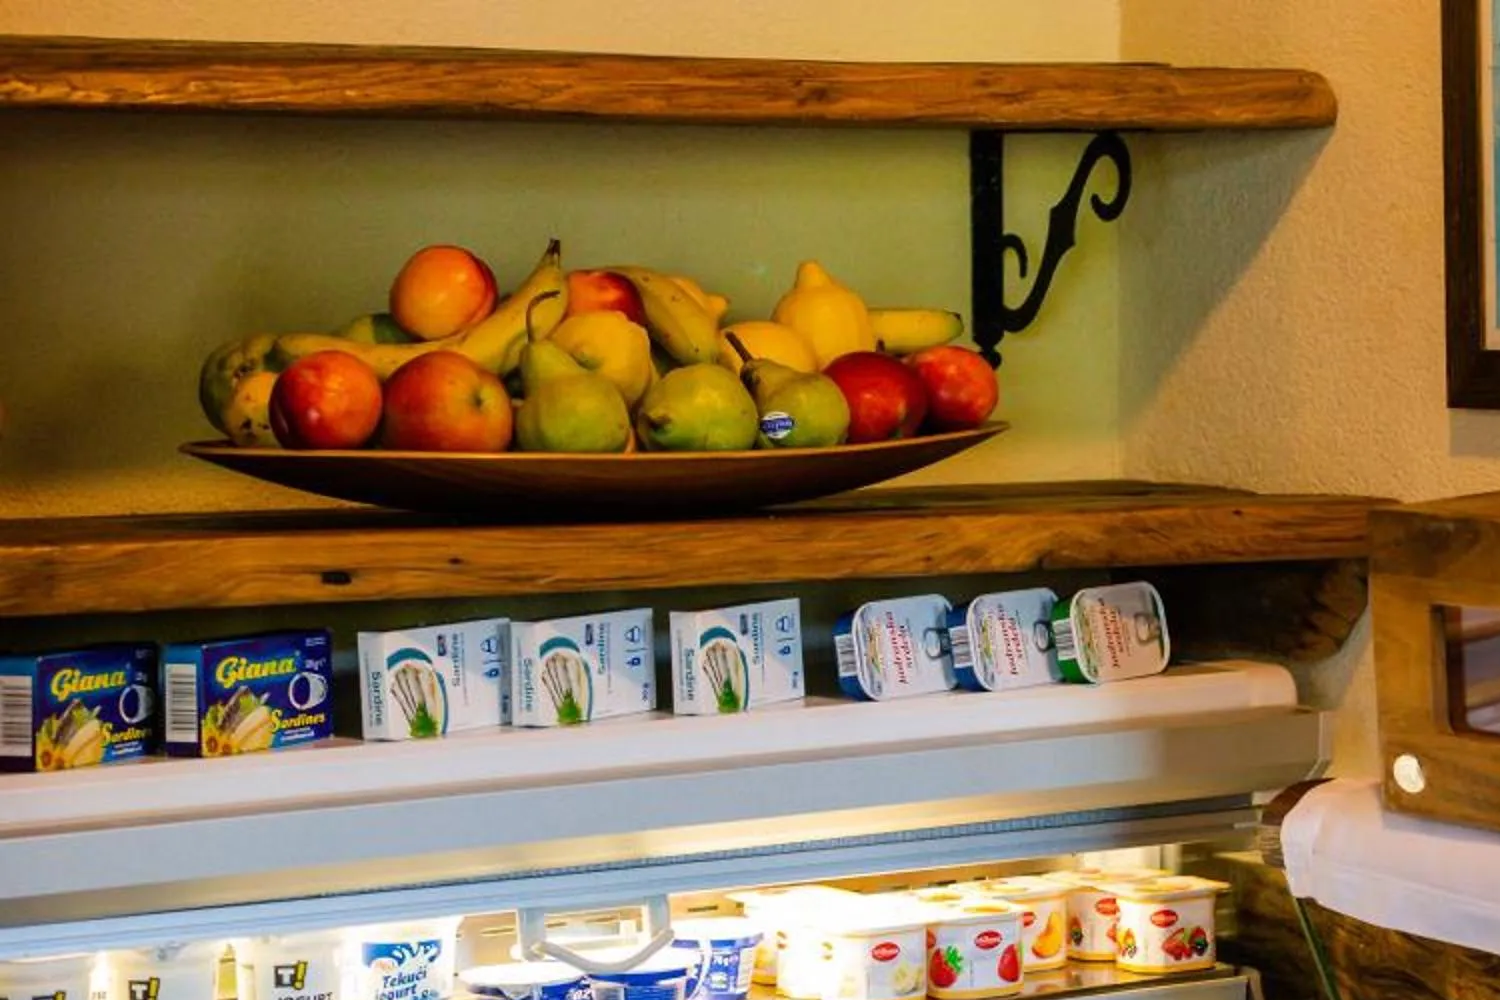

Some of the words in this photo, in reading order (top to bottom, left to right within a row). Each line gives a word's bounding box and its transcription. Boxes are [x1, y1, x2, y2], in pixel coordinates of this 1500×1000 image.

[51, 667, 126, 702] Giana
[215, 655, 297, 689] Giana
[523, 658, 534, 712] Sardine
[684, 648, 696, 701] Sardine
[371, 671, 383, 726] Sardine
[270, 708, 325, 733] Sardines
[383, 965, 427, 988] Tekući
